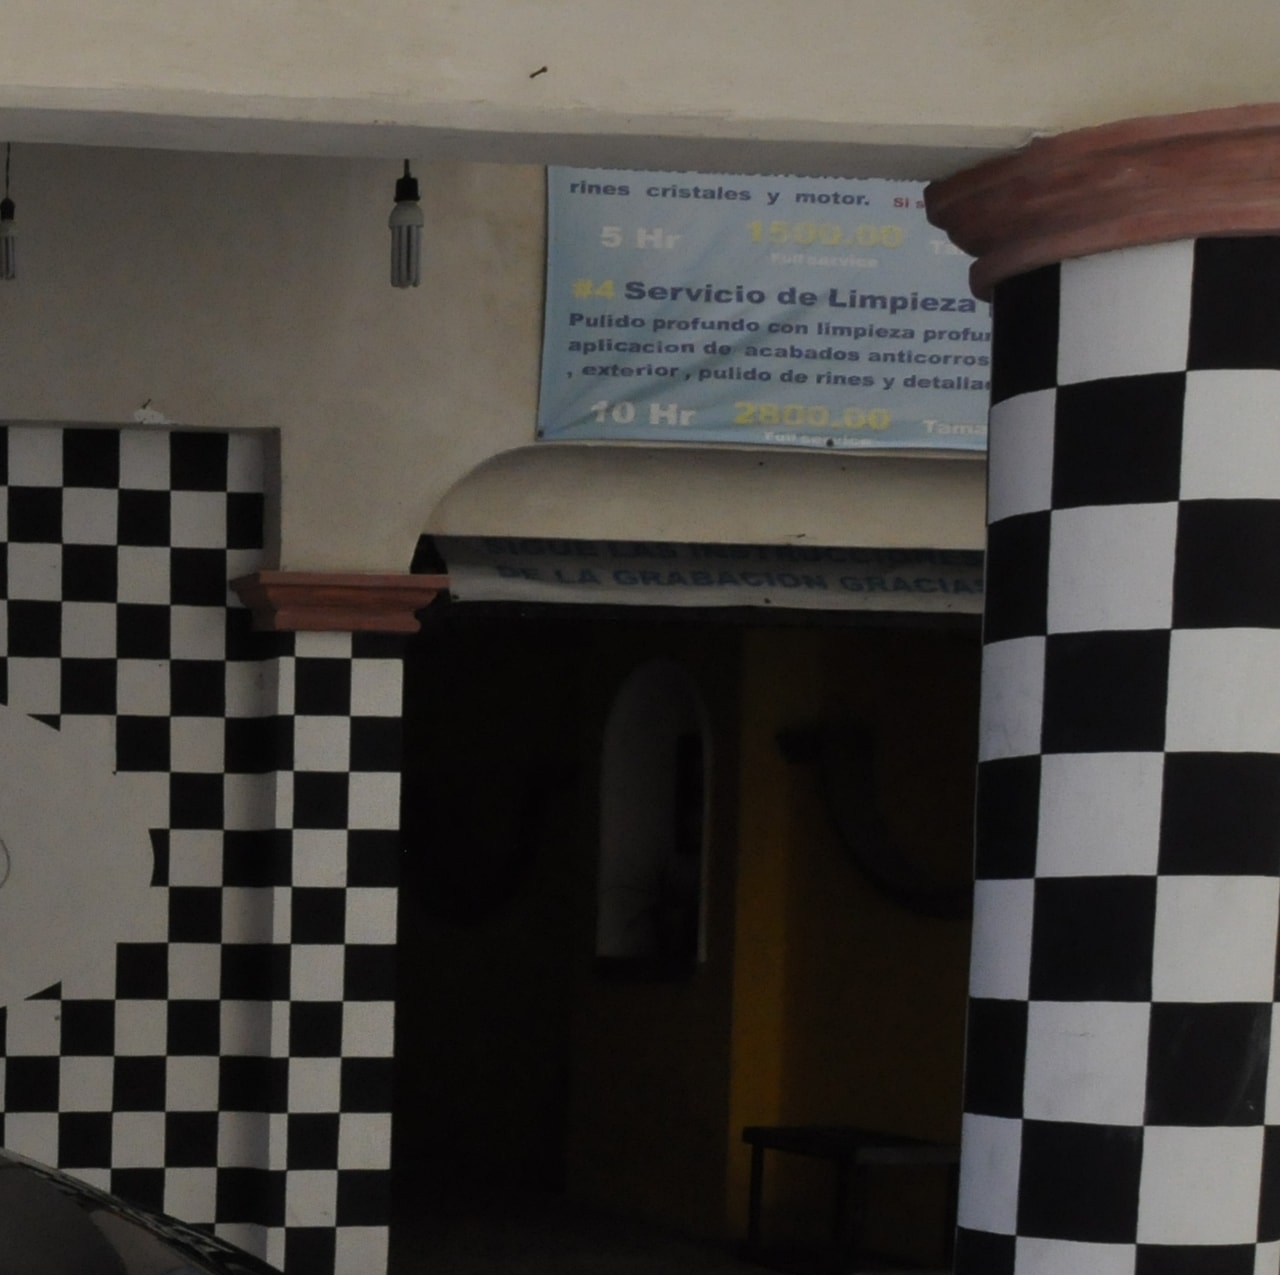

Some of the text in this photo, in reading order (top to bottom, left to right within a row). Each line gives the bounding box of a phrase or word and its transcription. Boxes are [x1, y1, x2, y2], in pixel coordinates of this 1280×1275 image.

[569, 180, 631, 197] rines
[646, 184, 752, 202] cristales
[767, 190, 781, 206] y
[795, 190, 871, 206] motor.
[601, 225, 624, 248] 5
[636, 227, 684, 250] Hr
[624, 280, 767, 305] Servicio
[776, 287, 818, 307] de
[828, 288, 977, 315] Limpieza
[568, 312, 646, 329] Pulido
[652, 316, 760, 333] profundo
[767, 320, 809, 335] con
[816, 321, 916, 340] limpieza
[567, 338, 991, 367] aplicacion de acabados anticorros
[581, 363, 681, 378] exterior
[698, 366, 772, 382] pulido
[779, 369, 809, 384] de
[815, 371, 876, 387] rines
[882, 376, 896, 391] y
[590, 400, 637, 425] 10
[648, 402, 697, 427] Hr
[733, 400, 892, 431] 2800.00
